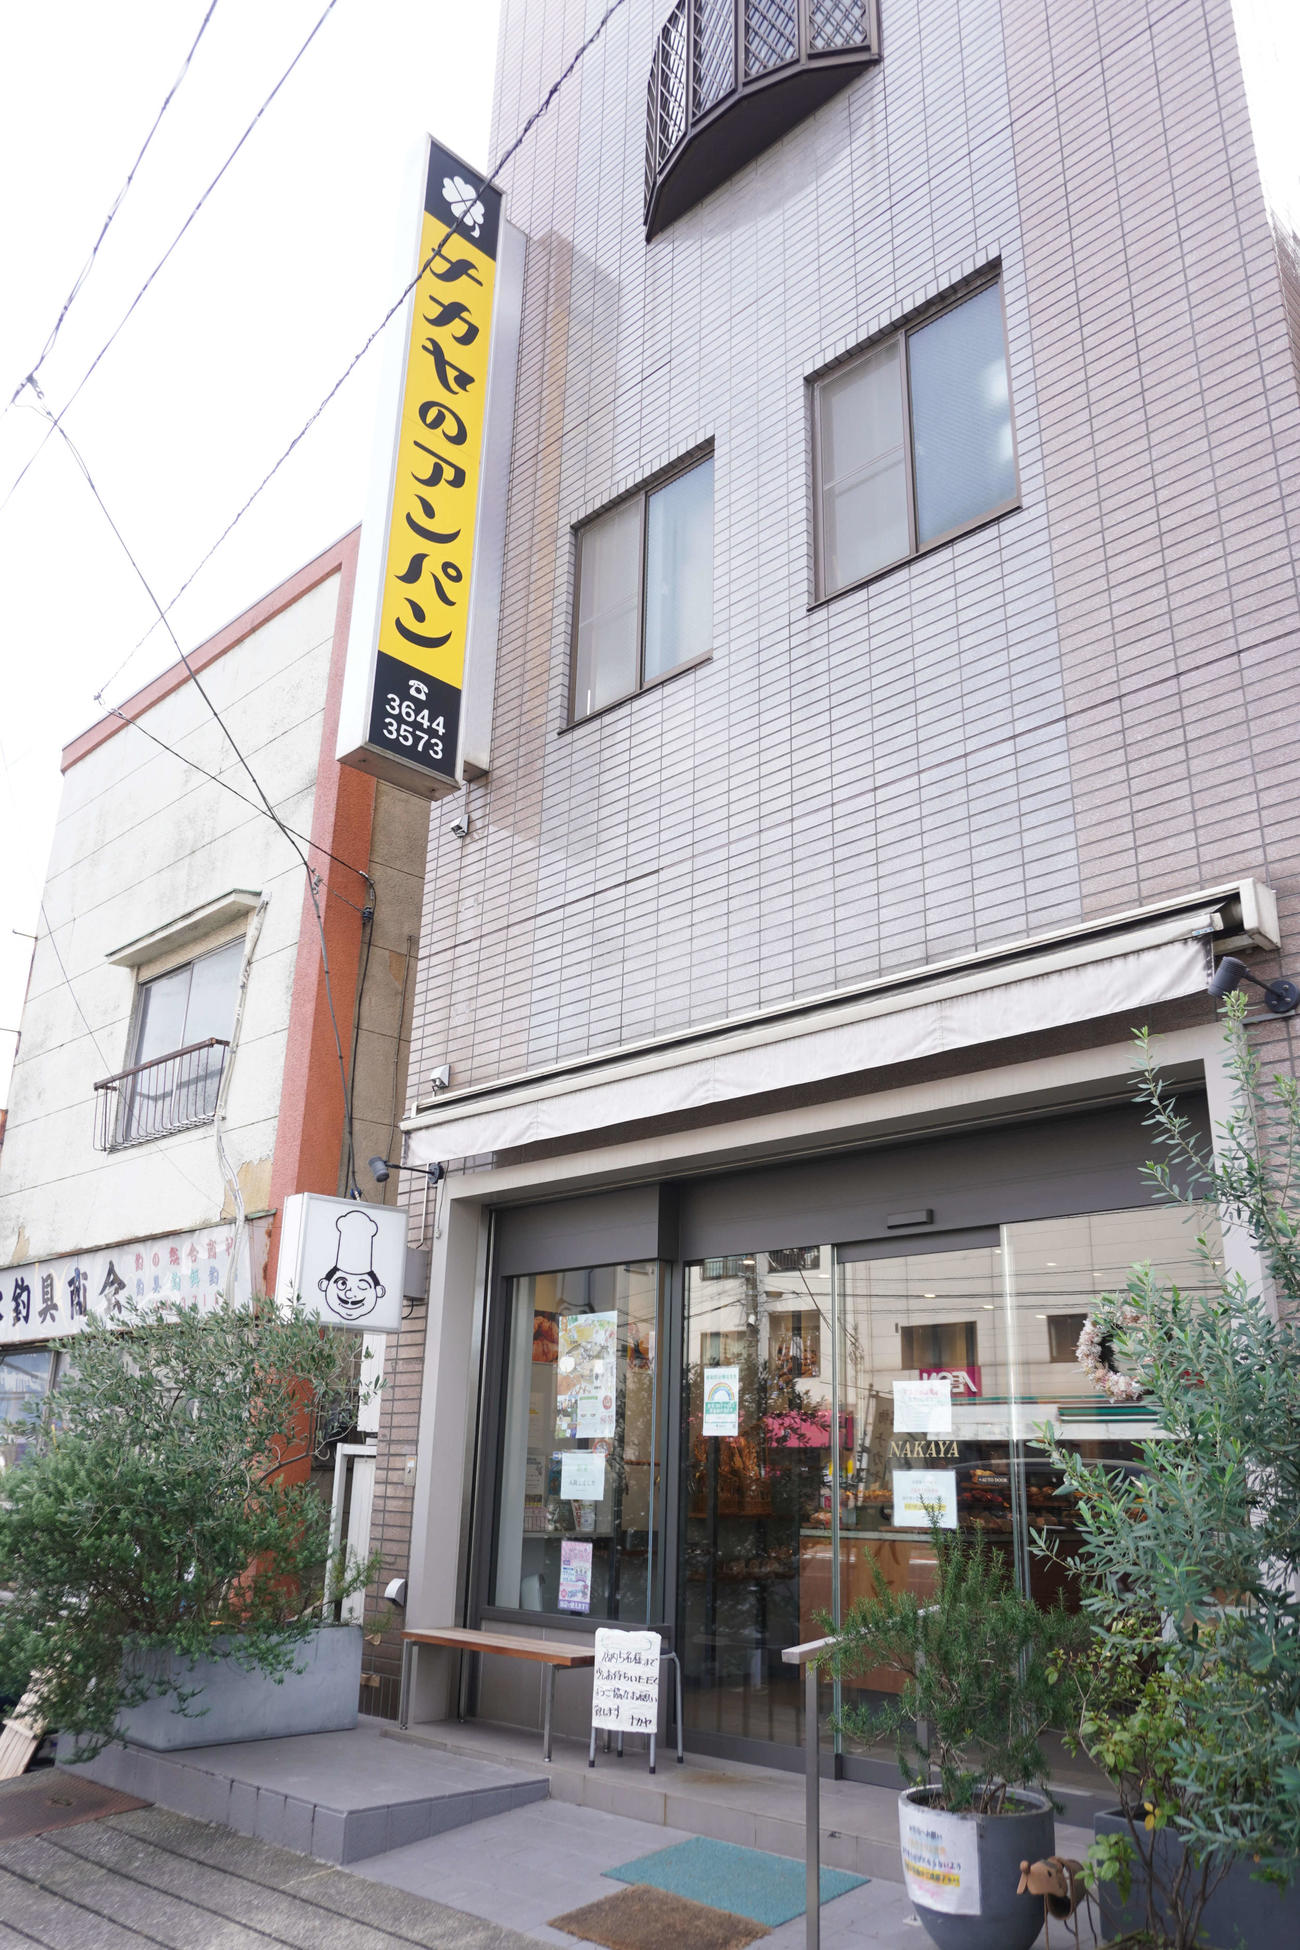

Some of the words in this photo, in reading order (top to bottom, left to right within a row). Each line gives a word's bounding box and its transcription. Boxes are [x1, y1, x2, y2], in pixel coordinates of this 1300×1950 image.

[394, 247, 483, 649] ナカヤのアンパン
[385, 693, 446, 736] 3644
[382, 717, 444, 760] 3573
[0, 1260, 127, 1327] 釣具商会
[888, 1440, 960, 1458] NAKAYA
